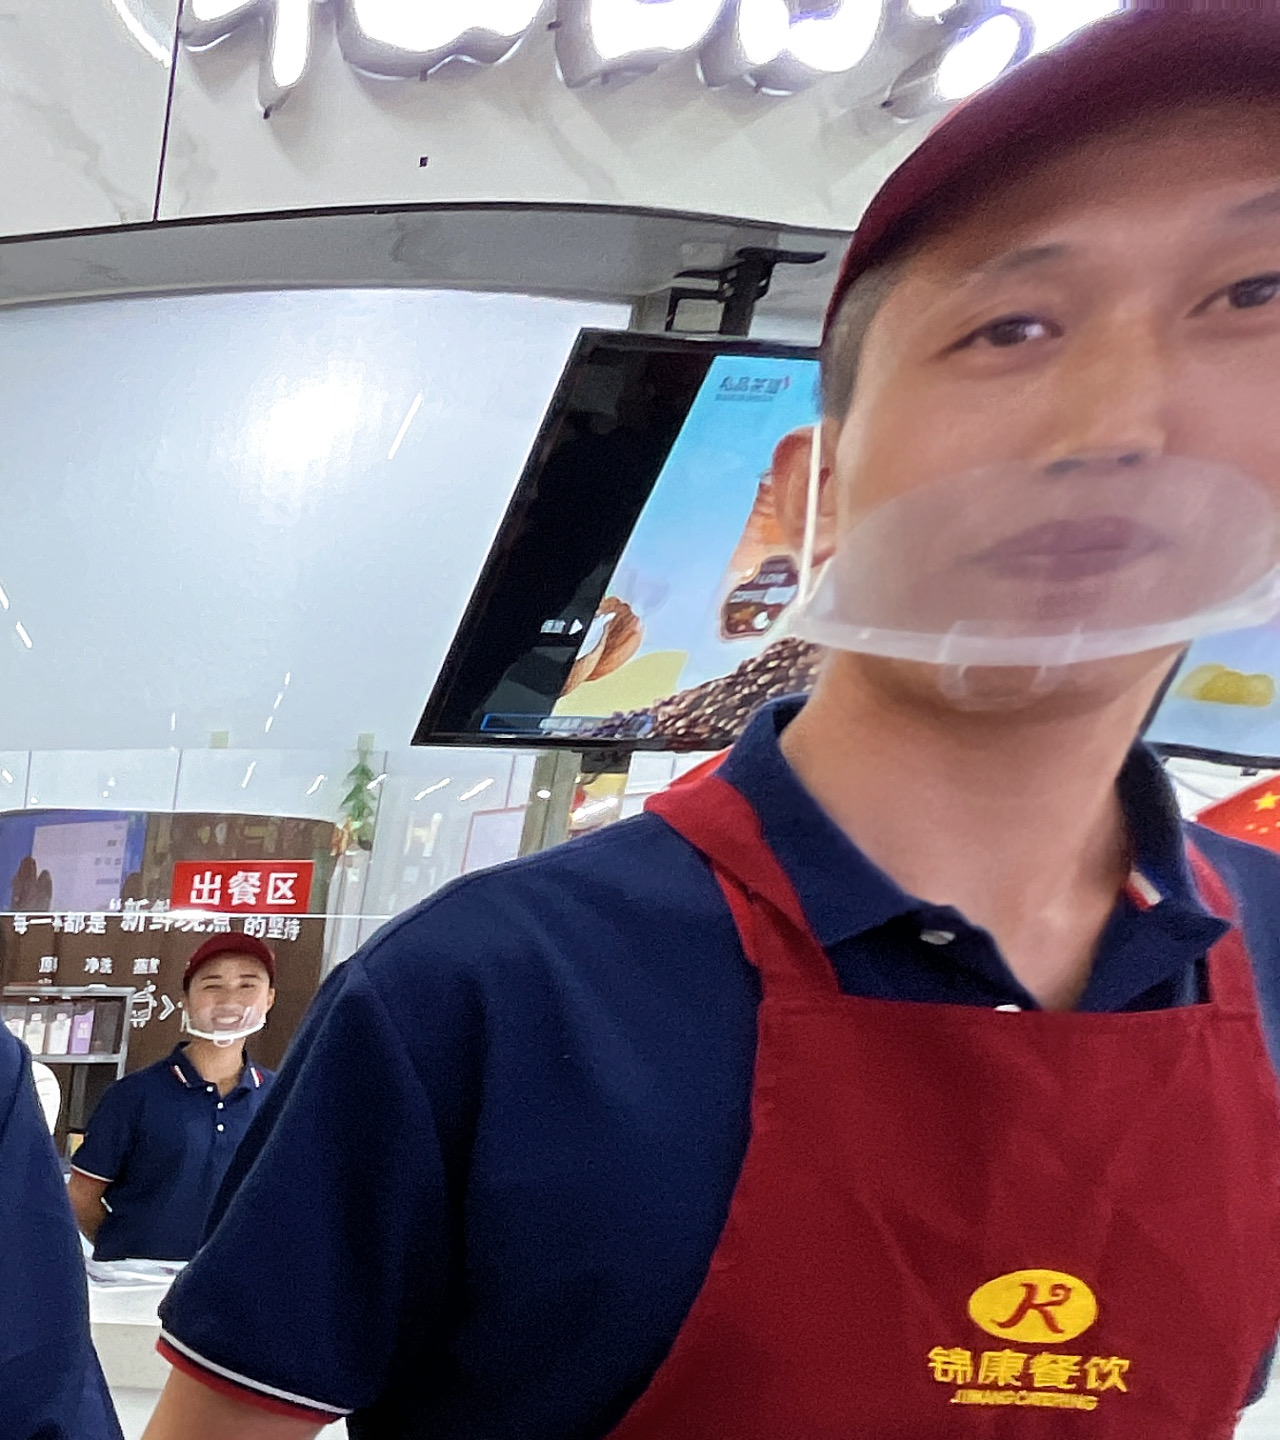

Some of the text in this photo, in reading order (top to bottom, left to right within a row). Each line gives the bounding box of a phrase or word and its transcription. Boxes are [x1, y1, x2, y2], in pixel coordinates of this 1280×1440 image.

[190, 871, 298, 905] 出餐区
[928, 1346, 1130, 1393] 锦康餐饮
